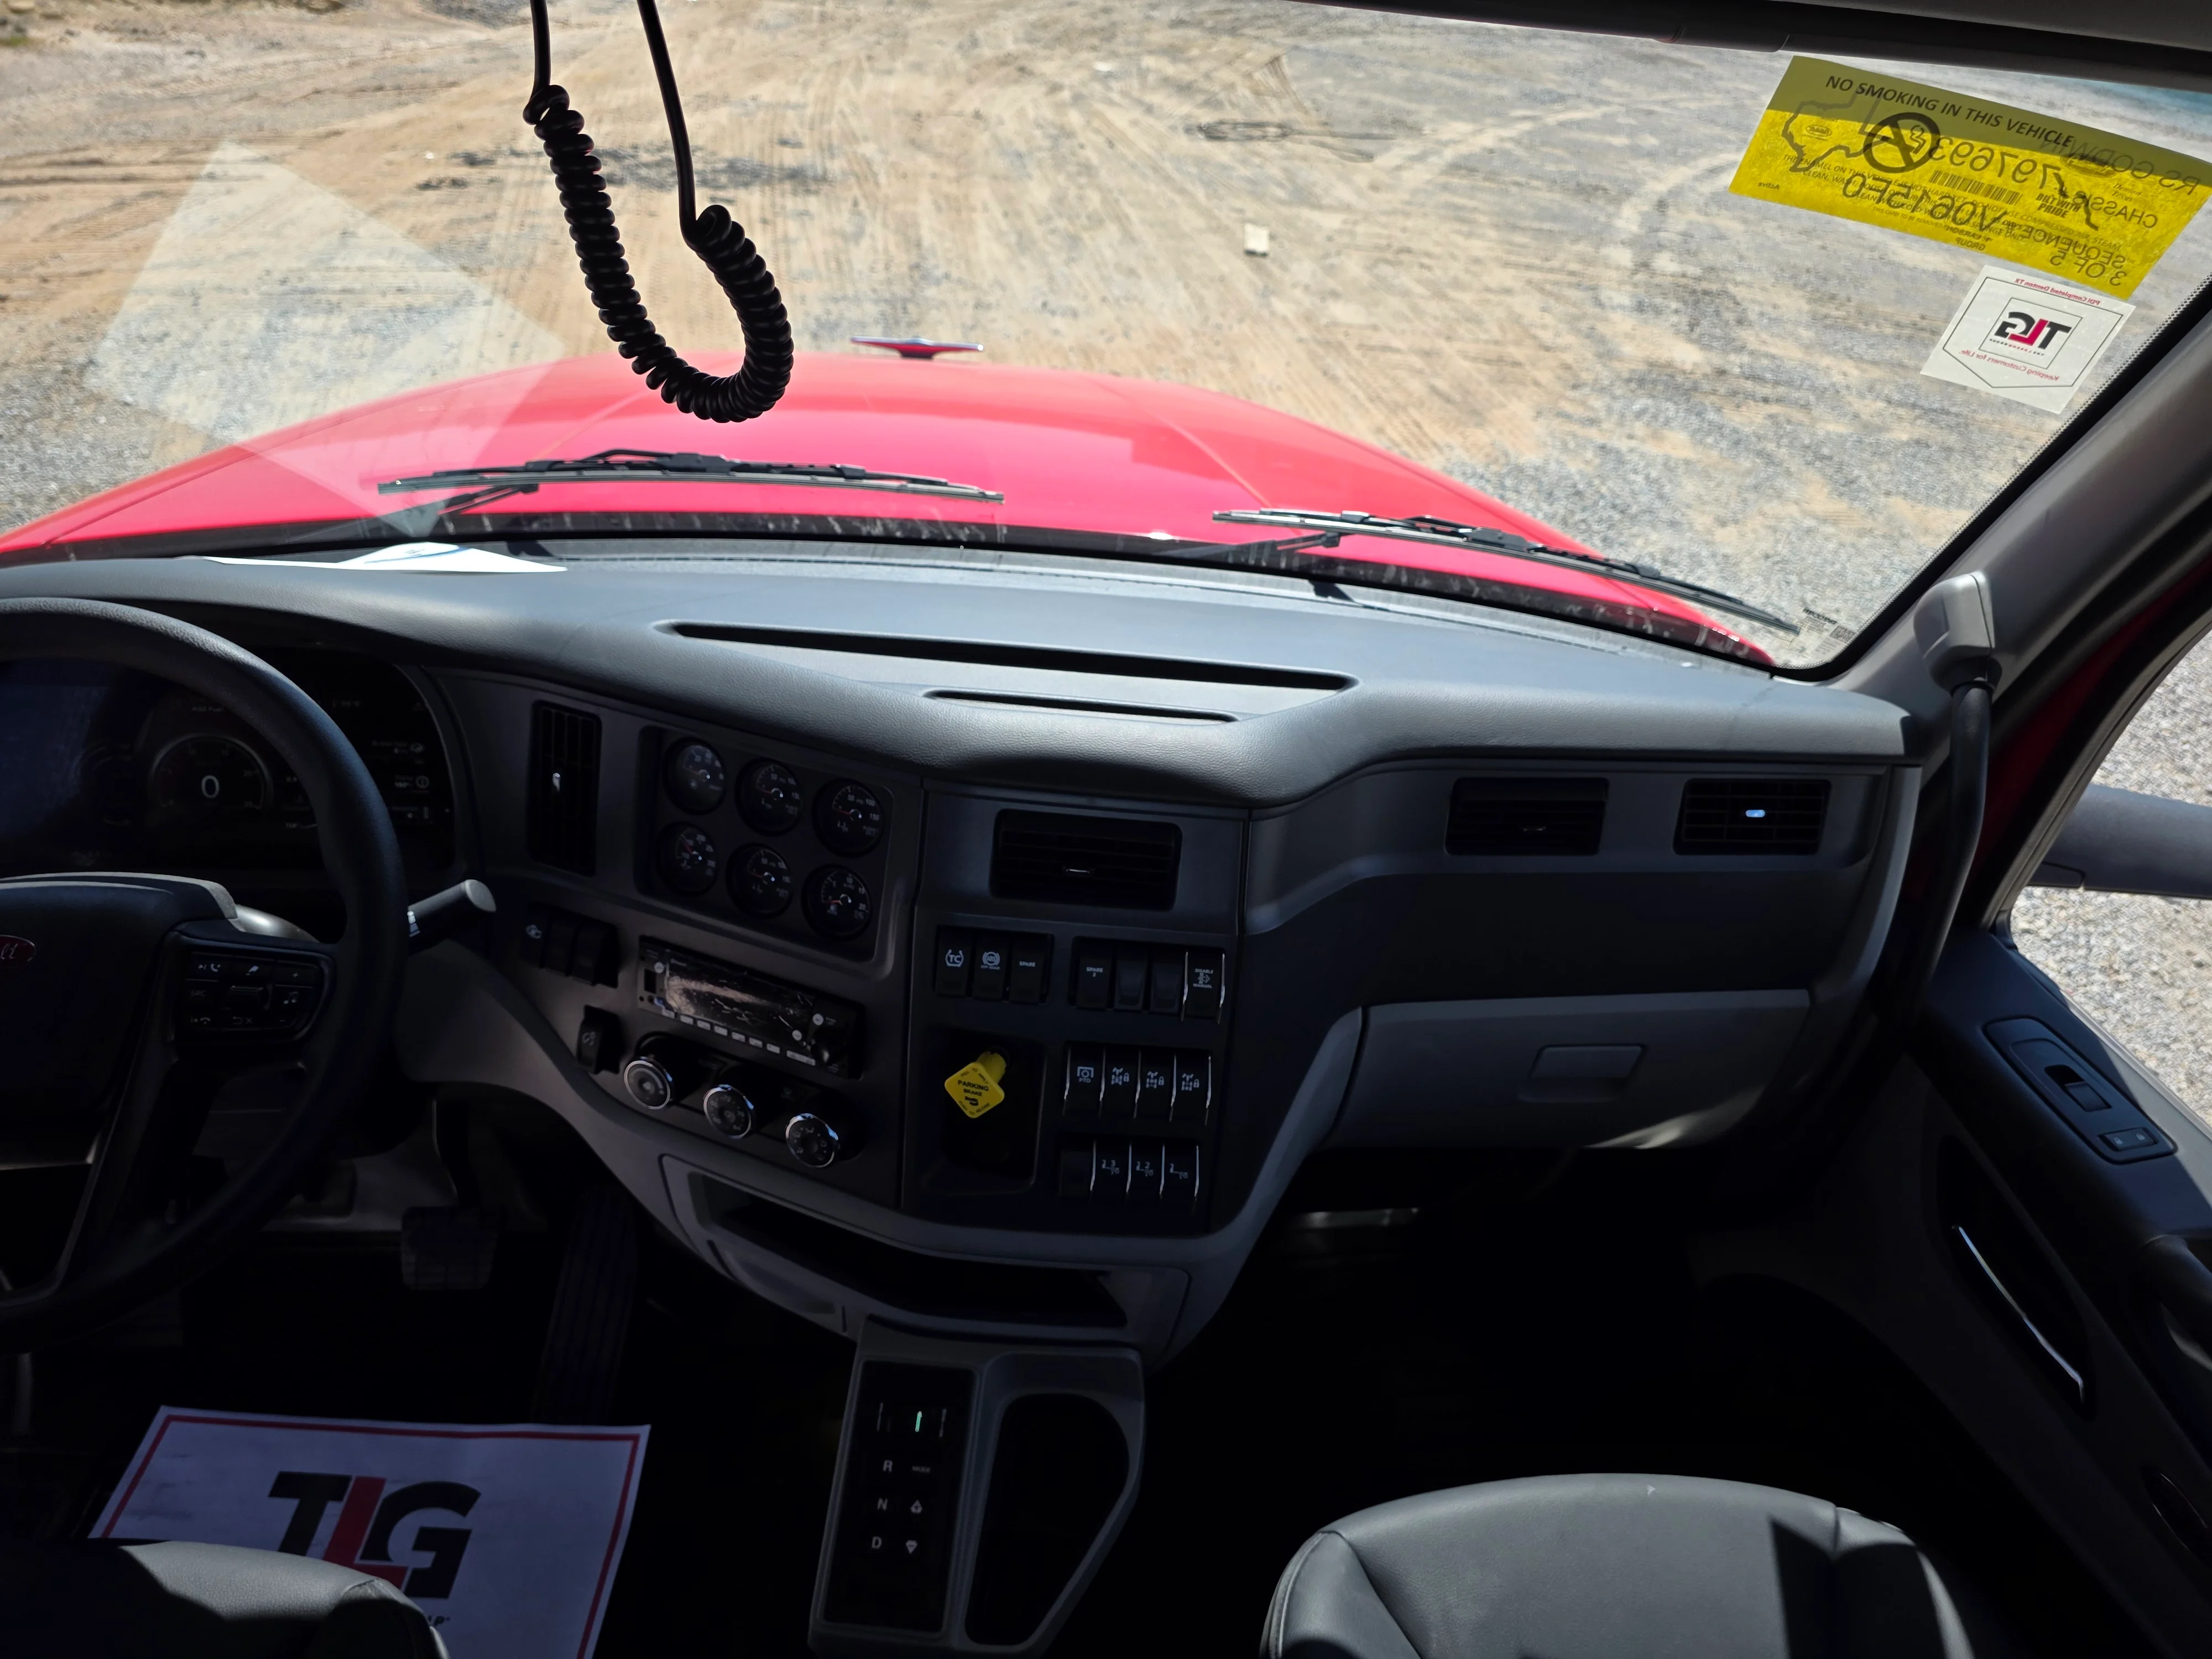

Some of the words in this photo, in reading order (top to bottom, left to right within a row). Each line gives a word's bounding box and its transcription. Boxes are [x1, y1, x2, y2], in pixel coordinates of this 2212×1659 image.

[1825, 75, 1854, 92] NO
[1855, 82, 1940, 111] SMOKING
[1940, 102, 1962, 117] IN
[1965, 107, 2001, 128] THIS
[2005, 117, 2076, 148] VEHICLE
[1833, 165, 1846, 174] ON
[2092, 236, 2122, 251] STEAM
[2037, 203, 2070, 218] PRIDE
[201, 774, 220, 799] 0
[948, 954, 962, 963] TC
[957, 1079, 989, 1092] PARKING
[963, 1088, 983, 1097] BRAKE
[882, 1459, 894, 1472] R
[876, 1496, 889, 1511] N
[268, 1470, 482, 1599] TLG
[870, 1535, 883, 1550] D
